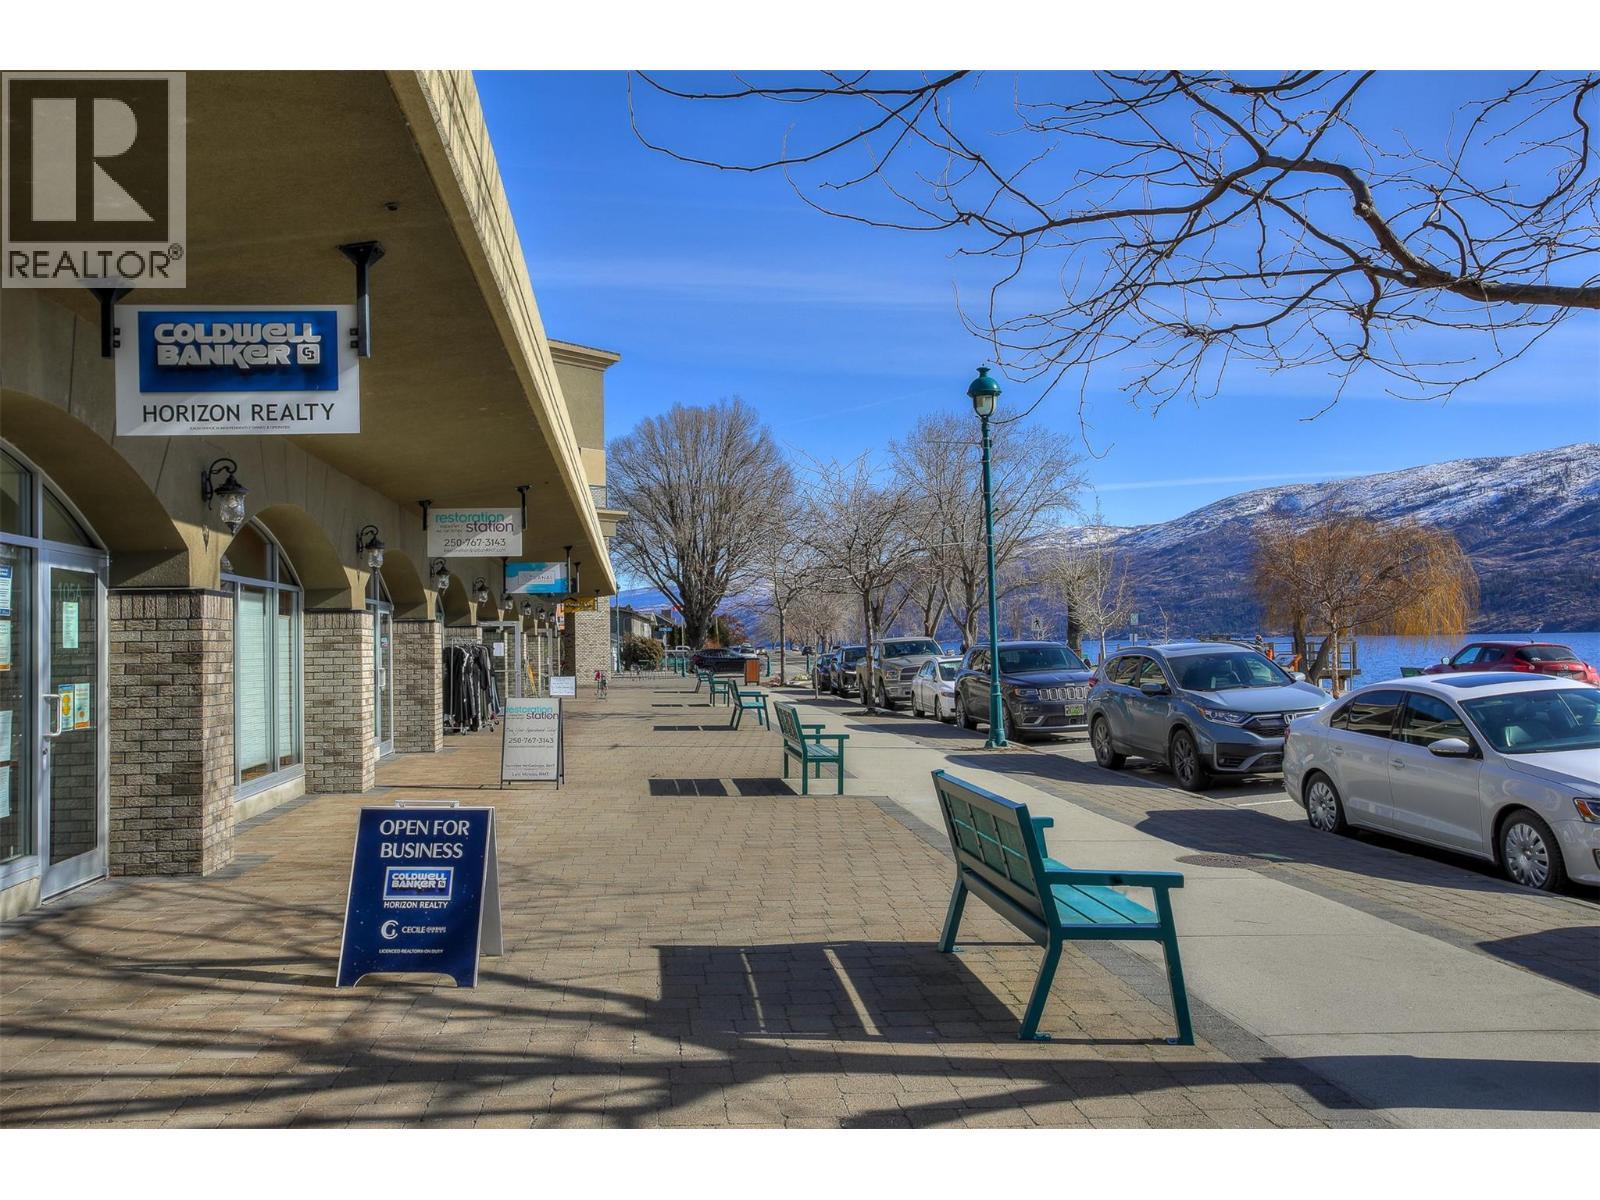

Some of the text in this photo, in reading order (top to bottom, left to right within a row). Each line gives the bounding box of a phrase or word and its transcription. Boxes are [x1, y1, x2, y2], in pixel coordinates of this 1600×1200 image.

[154, 322, 322, 344] COLDWELL
[156, 344, 293, 369] BANKER
[142, 402, 336, 423] HORIZON REALTY
[435, 511, 505, 523] restoration
[465, 520, 514, 533] station
[57, 582, 83, 602] 105A
[526, 711, 559, 720] station
[379, 819, 470, 836] OPEN FOR
[380, 842, 463, 859] BUSINESS
[391, 873, 447, 881] COLDWELL
[391, 880, 437, 889] BANKER
[383, 901, 449, 909] HORIZON REALTY
